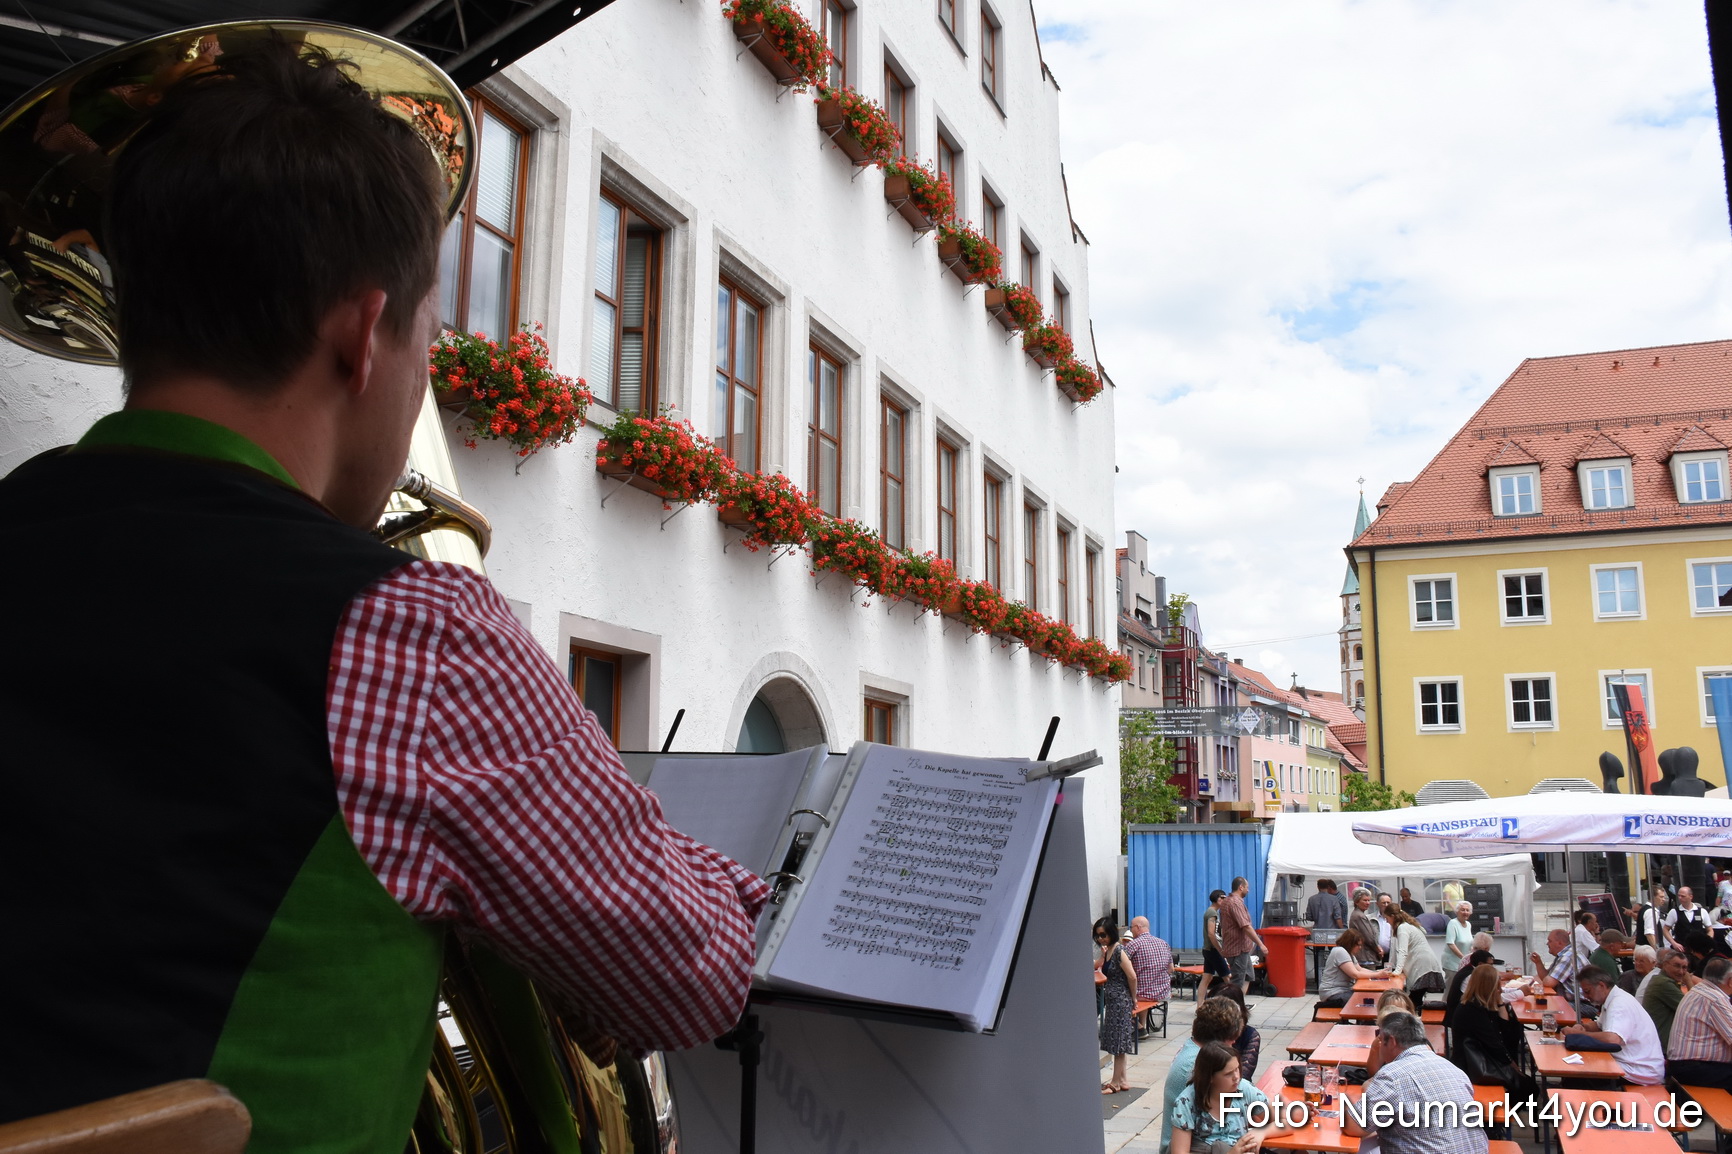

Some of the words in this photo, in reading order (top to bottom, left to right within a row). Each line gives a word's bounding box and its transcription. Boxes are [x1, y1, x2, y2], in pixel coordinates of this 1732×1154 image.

[937, 766, 959, 776] Kapelle
[1420, 817, 1498, 832] GANSBRÄU
[1644, 814, 1732, 828] GANSBRÄU
